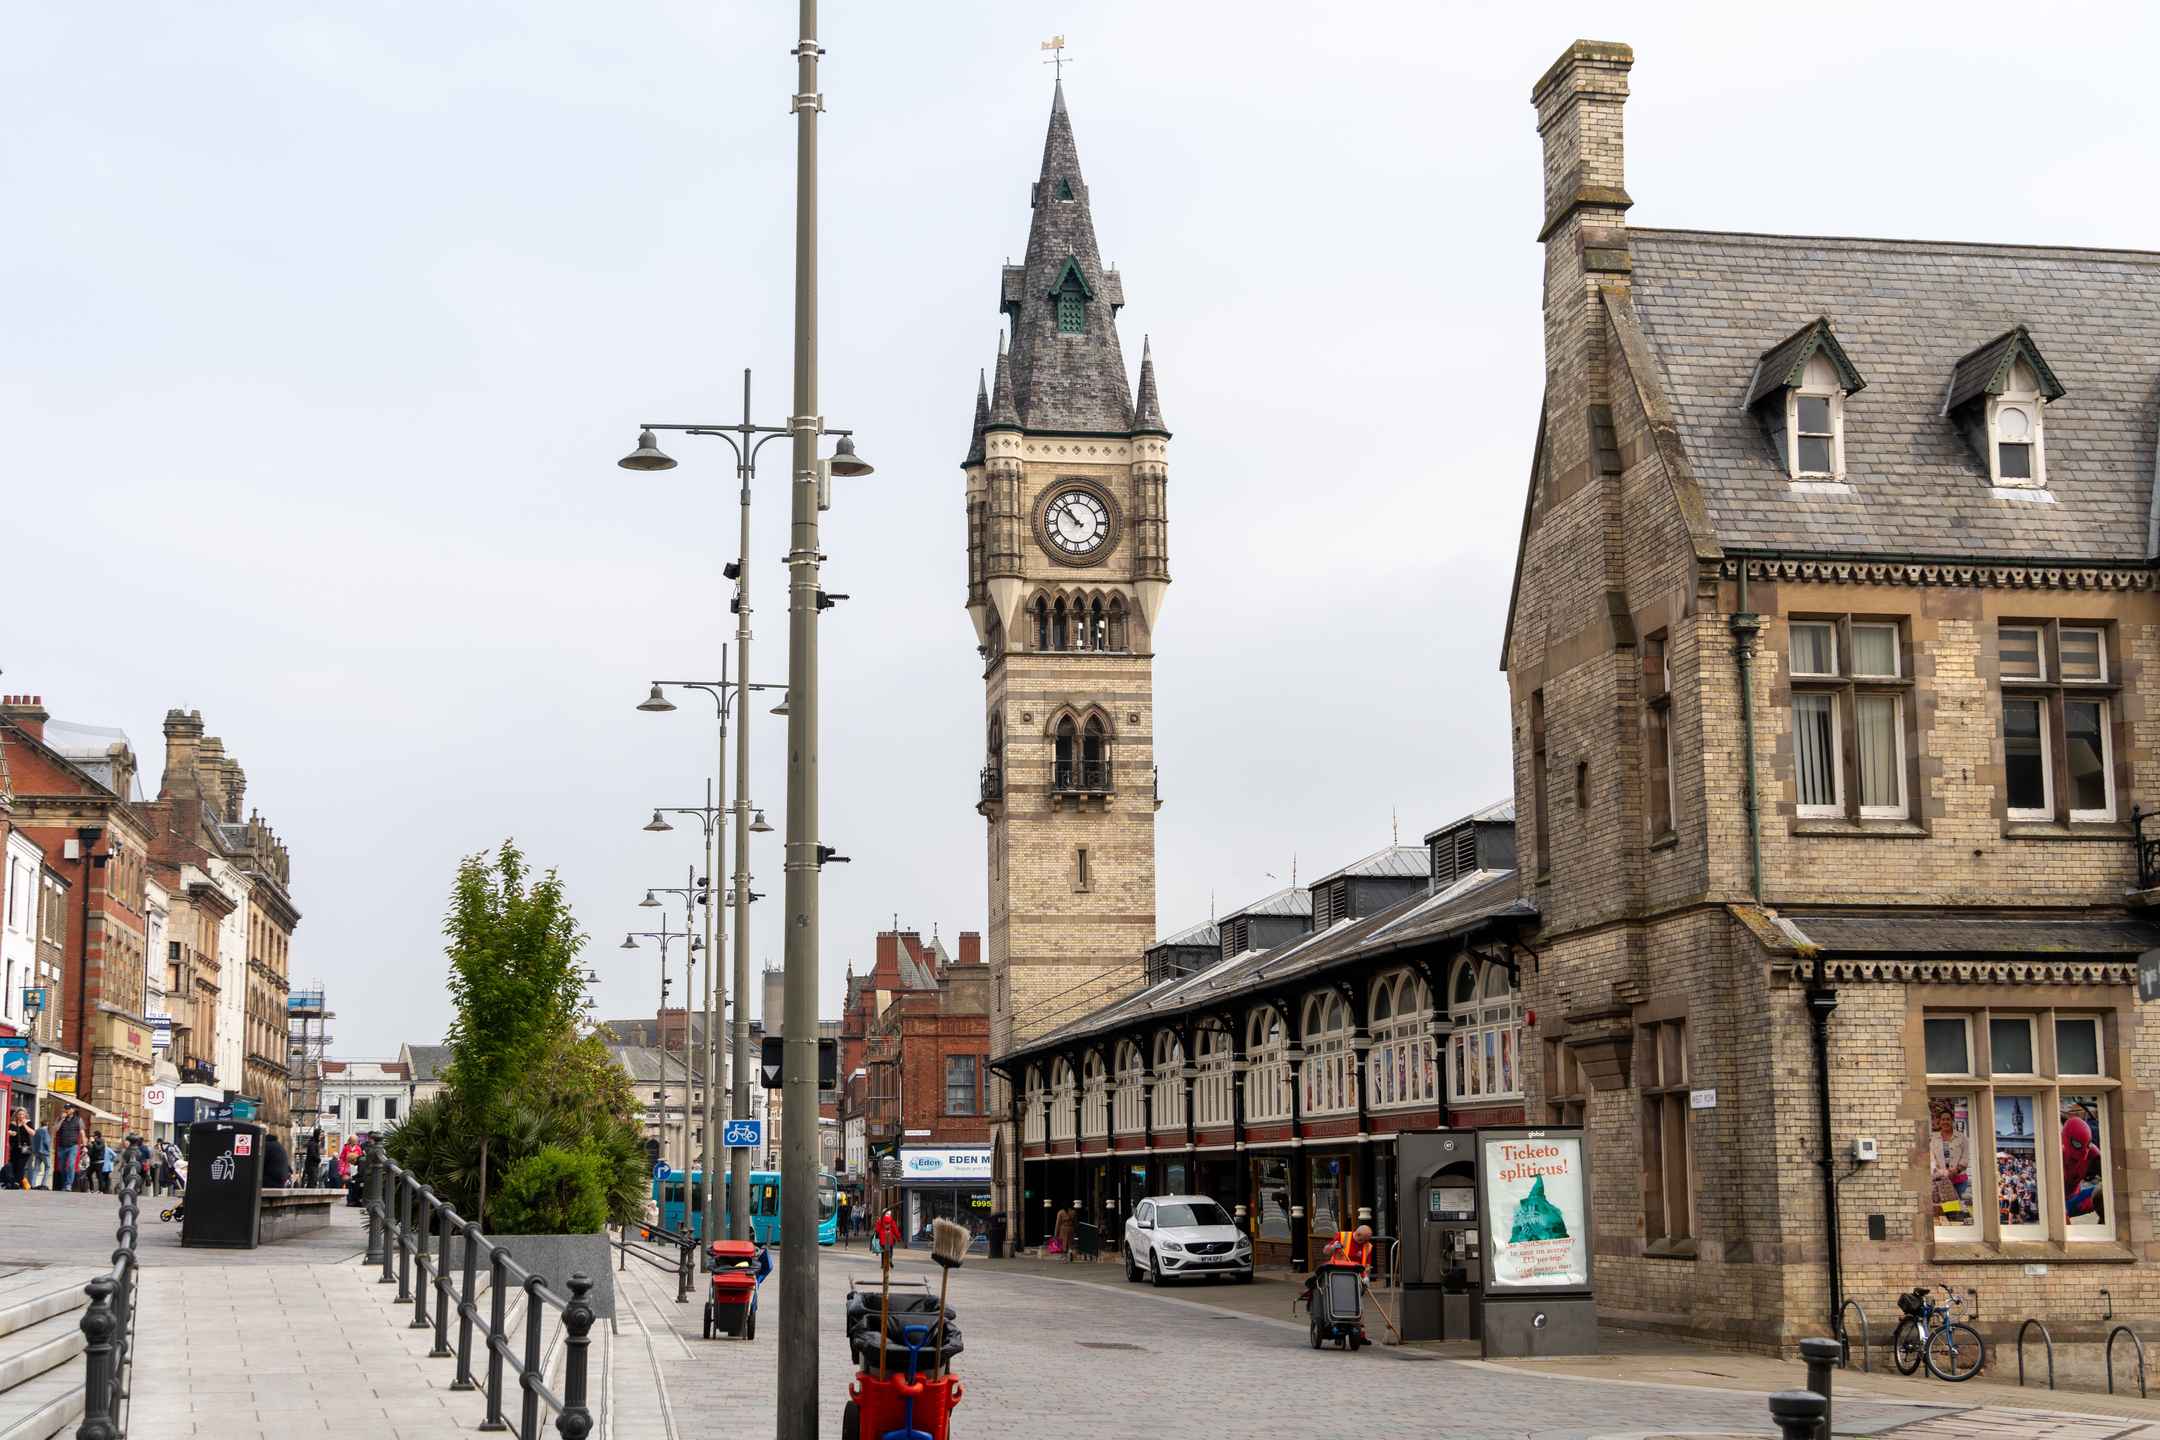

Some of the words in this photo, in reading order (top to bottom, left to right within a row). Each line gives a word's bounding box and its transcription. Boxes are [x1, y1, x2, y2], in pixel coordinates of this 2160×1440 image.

[1501, 1144, 1559, 1160] Ticketo
[918, 1158, 940, 1167] Eden
[949, 1155, 978, 1164] EDEN
[1499, 1159, 1568, 1182] spliticus!
